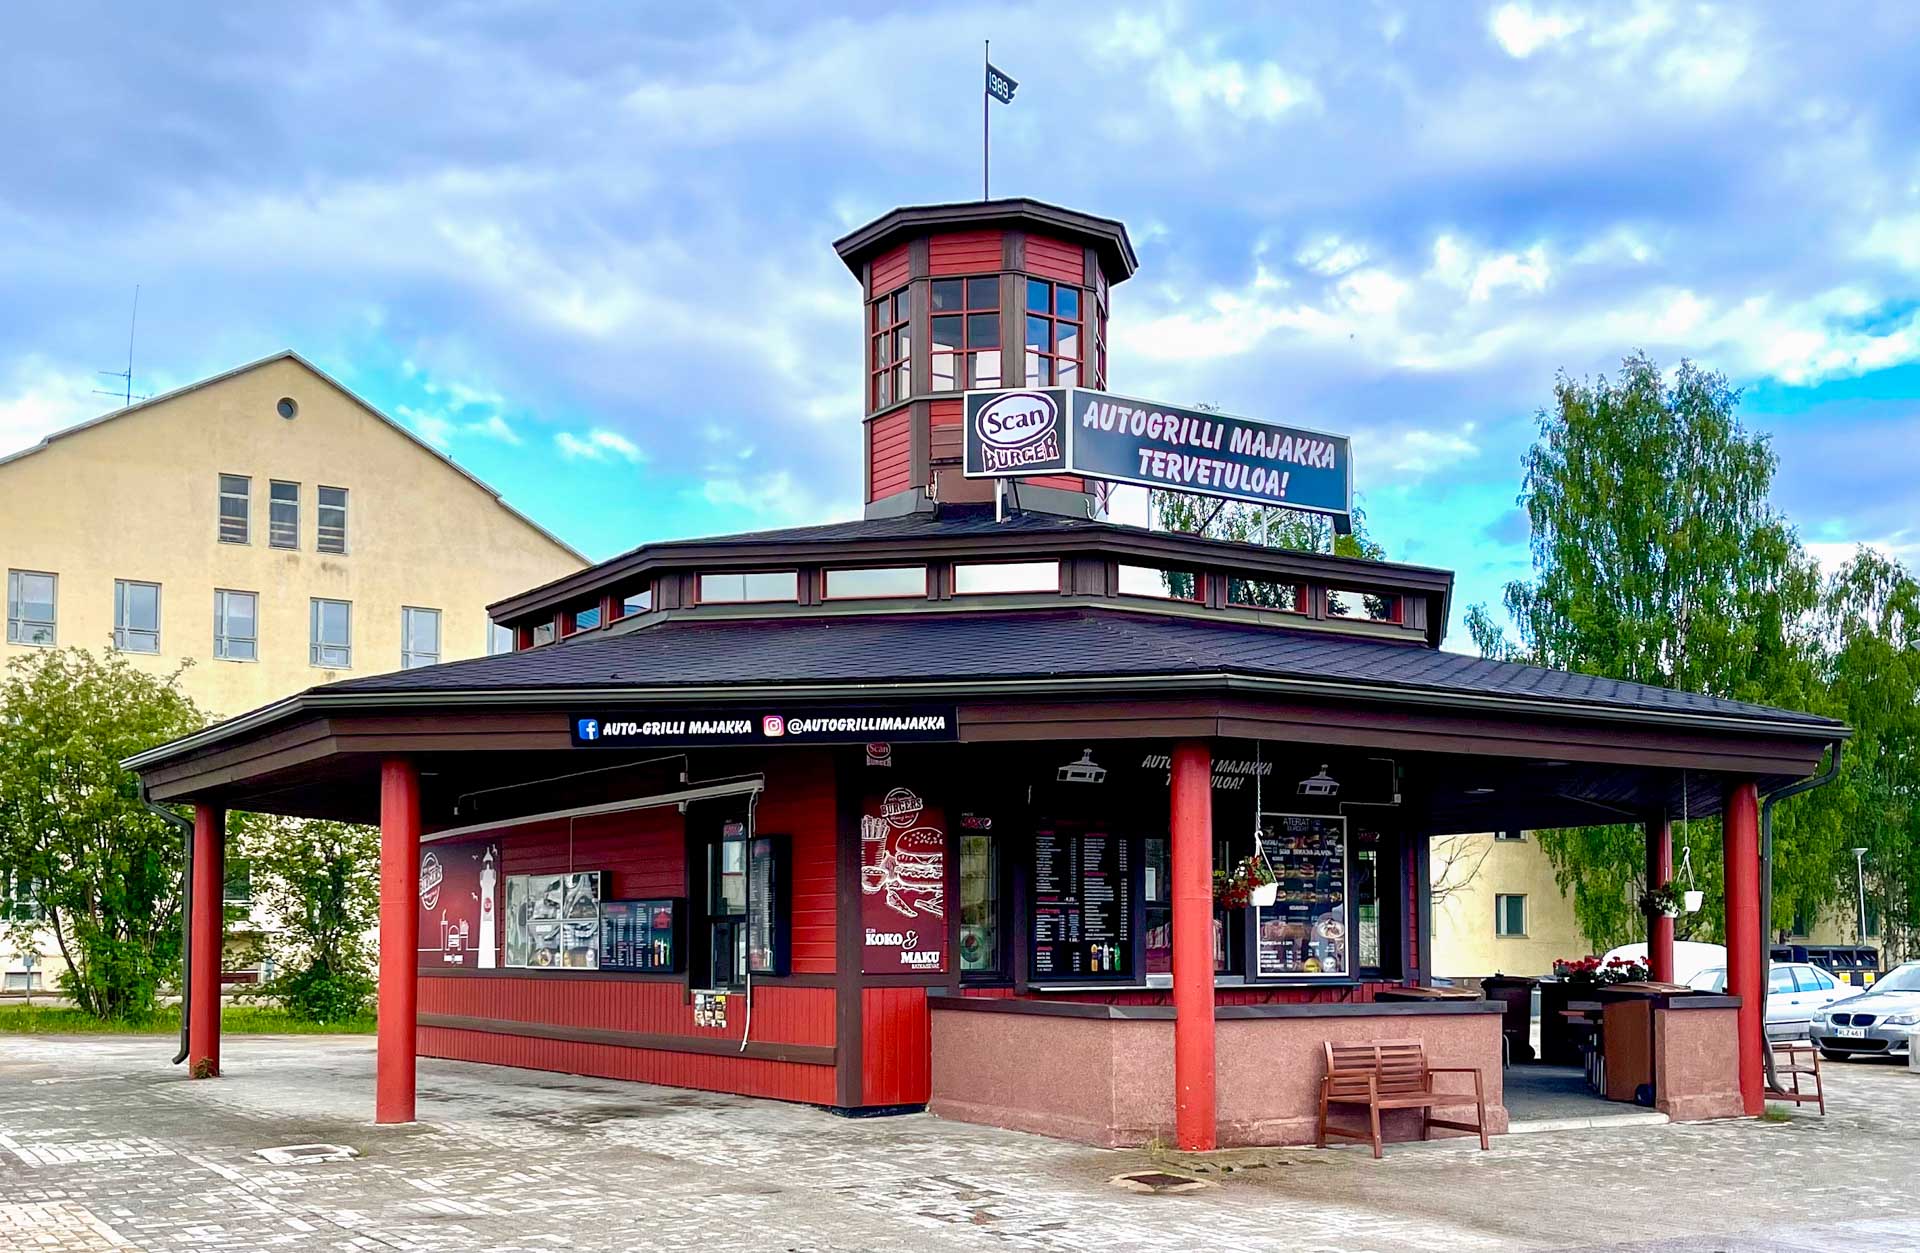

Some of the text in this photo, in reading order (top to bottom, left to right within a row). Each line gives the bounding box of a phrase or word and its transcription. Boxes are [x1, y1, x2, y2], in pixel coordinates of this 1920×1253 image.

[989, 72, 1008, 99] 1989
[987, 409, 1045, 434] Scan
[1083, 401, 1335, 469] AUTOGRILLI MAJAKKA
[982, 429, 1060, 473] BURGER
[1139, 448, 1289, 497] TERVETULOA!
[603, 721, 685, 736] AUTO-GRILLI
[688, 720, 752, 735] MAJAKKA
[787, 716, 945, 735] @AUTOGRILLIMAJAKKA
[1215, 759, 1273, 776] MAJAKKA
[880, 797, 923, 817] BURGERS
[865, 933, 903, 946] KOKO
[900, 952, 940, 964] MAKU
